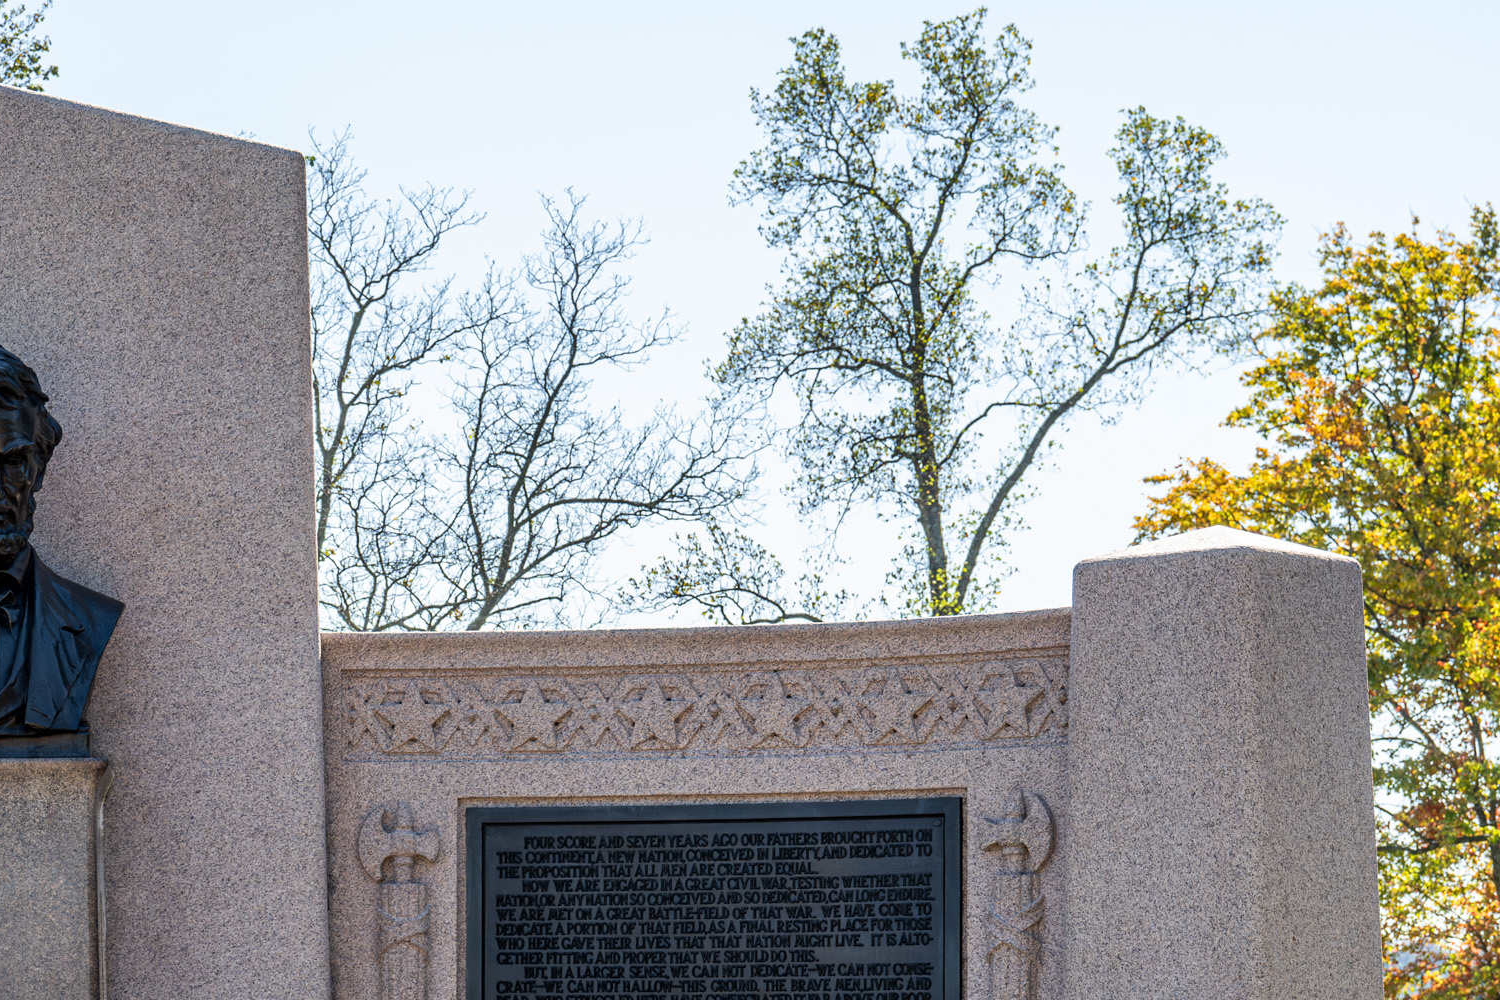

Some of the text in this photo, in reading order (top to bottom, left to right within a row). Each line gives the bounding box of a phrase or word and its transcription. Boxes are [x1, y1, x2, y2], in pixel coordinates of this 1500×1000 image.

[524, 829, 933, 849] FOUR SCORE AND SEVEN YEARS AGO OUR FATHERS BROUGHT FORTH ON
[497, 862, 818, 879] THE PROPOSITION THAT ALL MEN ARE CREATED EQUAL.
[496, 933, 934, 950] WHO HERE GAVE THEIR LIVES THAT THAT NATION MIGHT LIVE. IT IS ALTO-
[496, 950, 819, 965] GETHER FITTING AND PROPER THAT WE SHOULD DO THIS.
